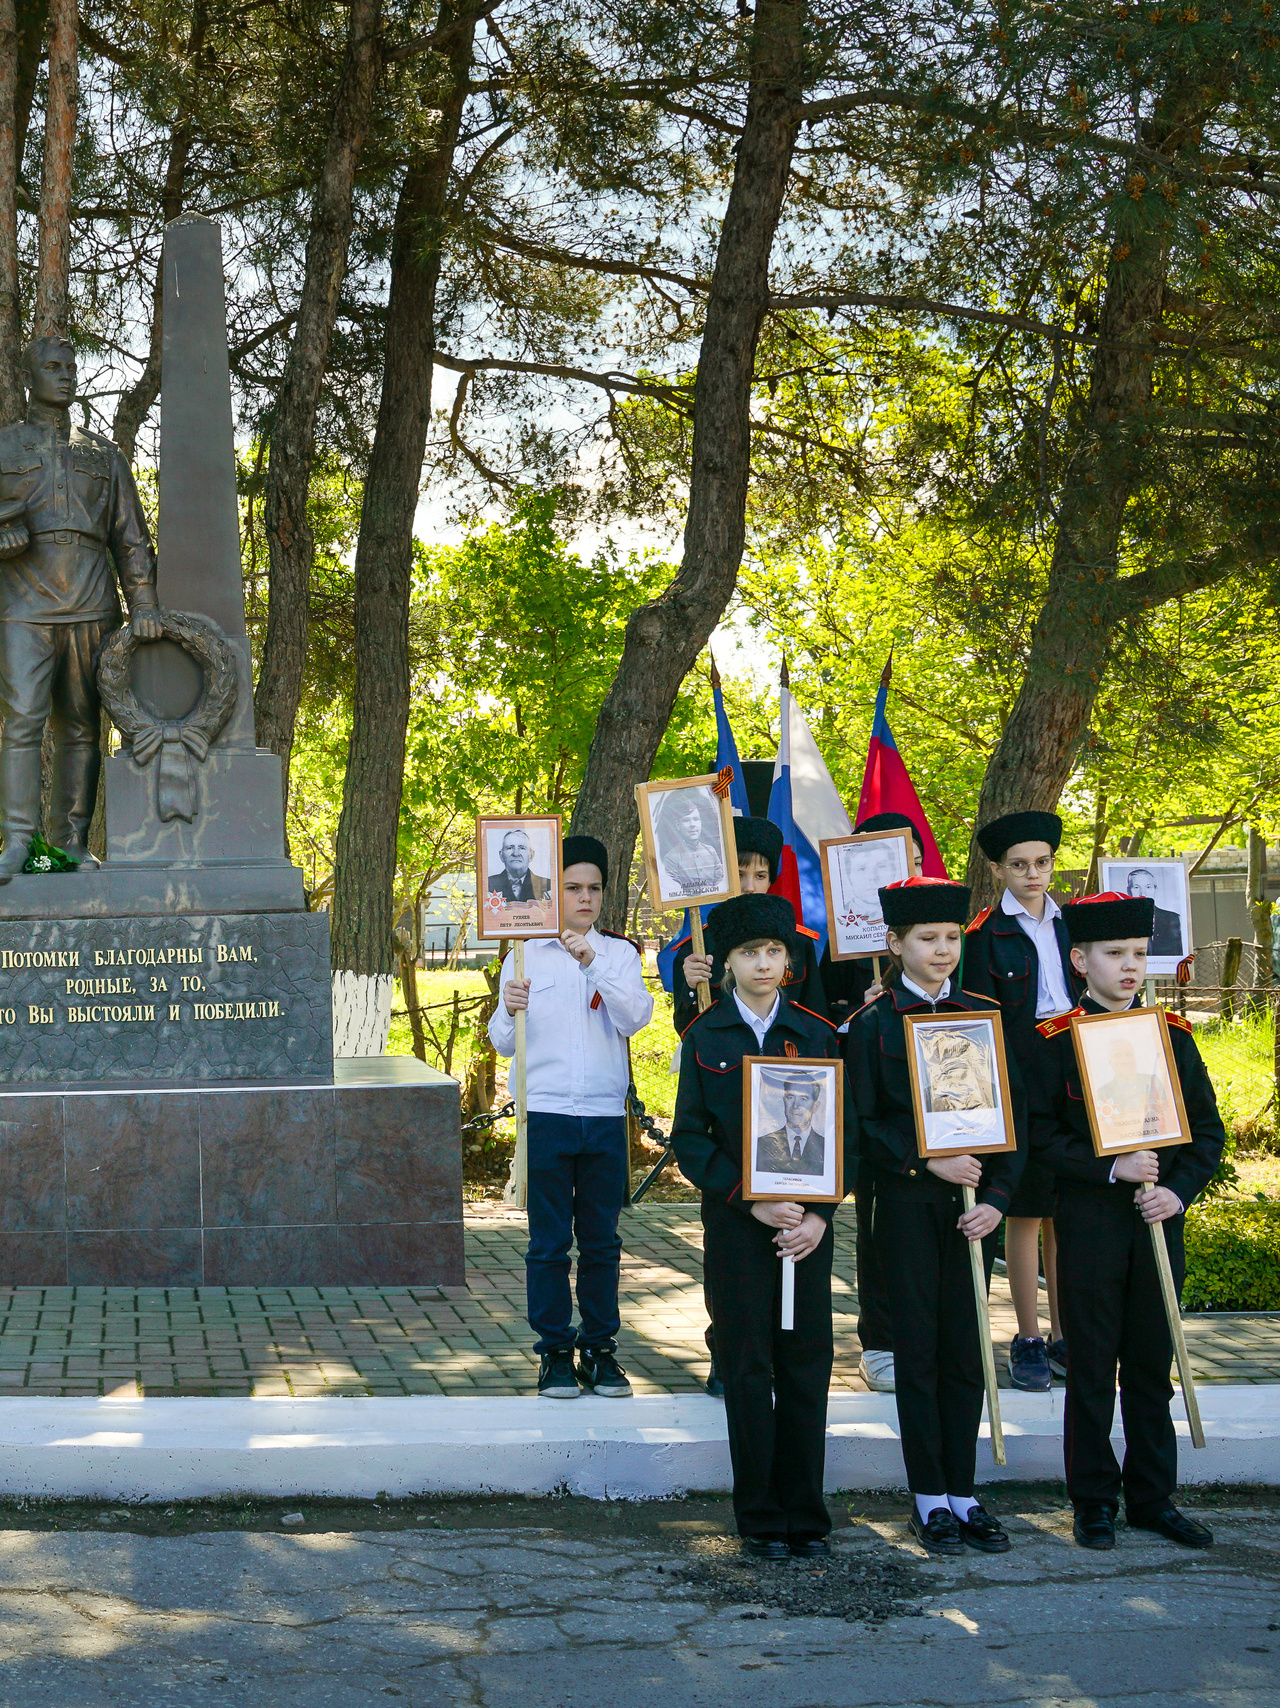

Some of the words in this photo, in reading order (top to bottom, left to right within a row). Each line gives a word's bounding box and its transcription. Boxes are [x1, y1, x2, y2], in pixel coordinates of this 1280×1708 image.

[94, 947, 203, 968] БЛАГОДАРНЫ
[65, 977, 137, 998] РОДНЫЕ,
[149, 976, 168, 992] ЗА
[180, 975, 206, 992] ТО,
[67, 1004, 156, 1023] ВЫСТОЯЛИ
[168, 1004, 181, 1021] И
[193, 1000, 285, 1021] ПОБЕДИЛИ.
